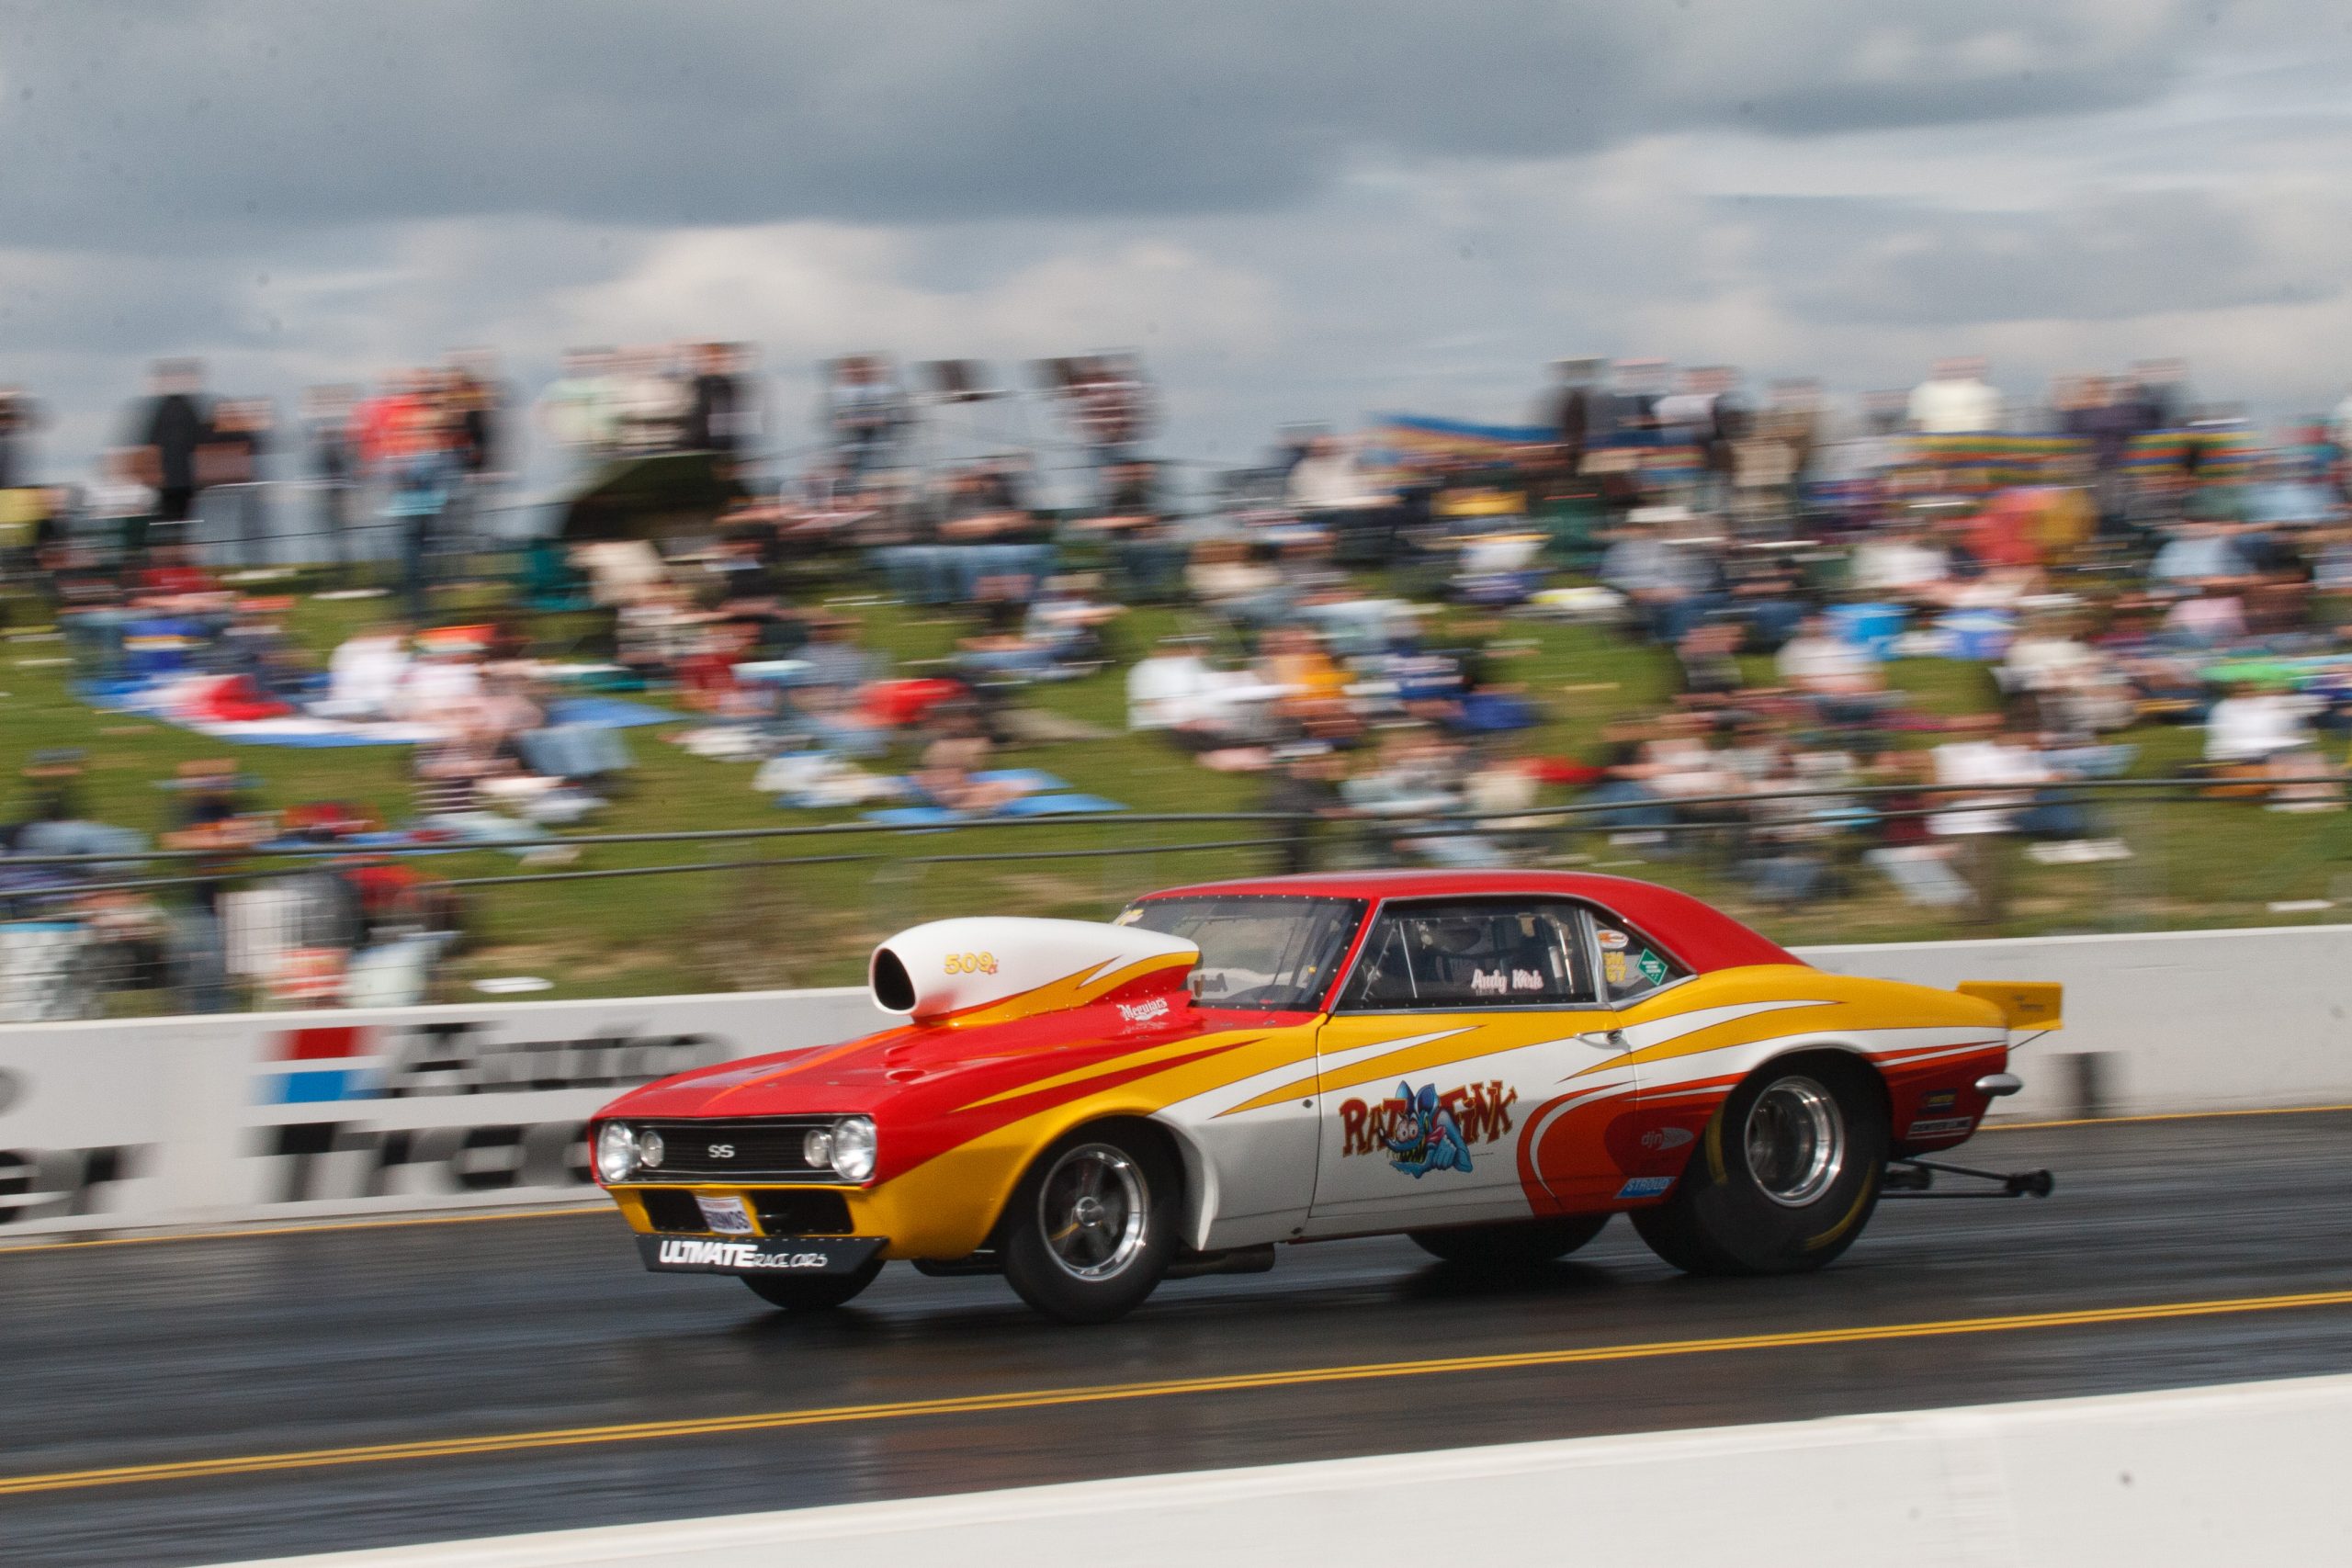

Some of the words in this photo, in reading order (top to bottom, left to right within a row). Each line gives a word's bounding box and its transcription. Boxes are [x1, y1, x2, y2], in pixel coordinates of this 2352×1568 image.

[944, 951, 994, 975] 509
[1340, 1097, 1408, 1158] RAT
[708, 1145, 735, 1158] SS
